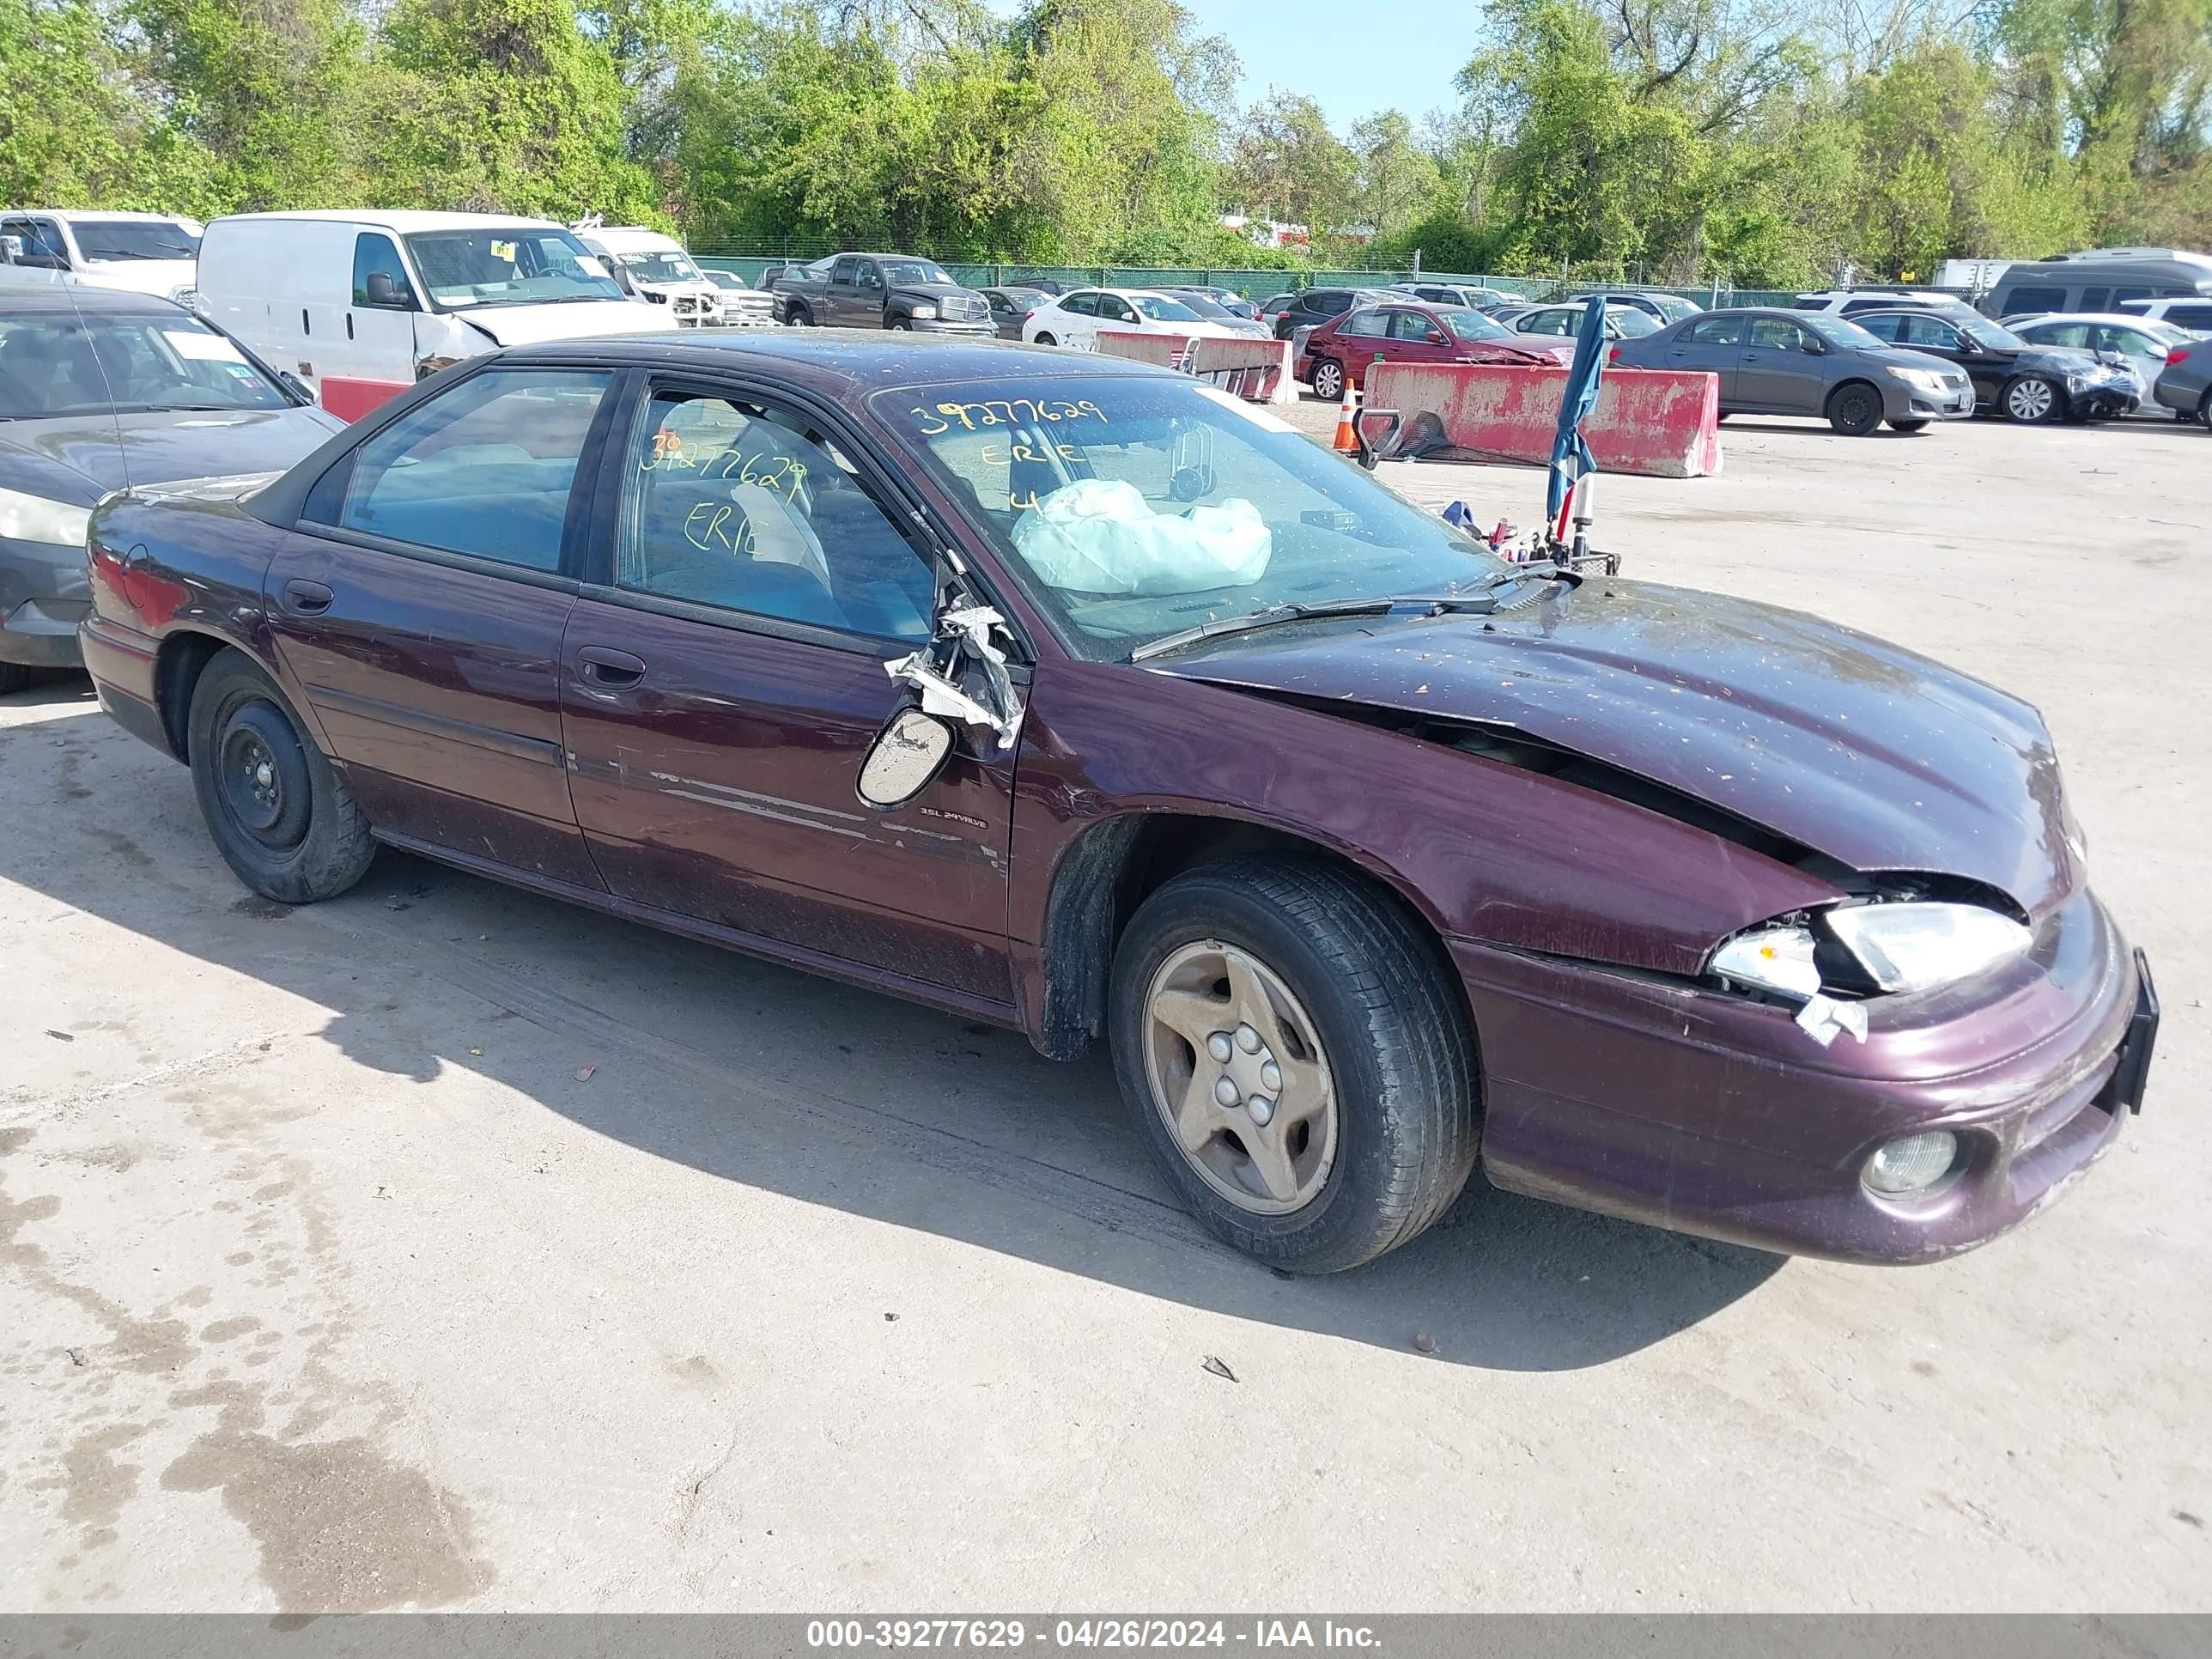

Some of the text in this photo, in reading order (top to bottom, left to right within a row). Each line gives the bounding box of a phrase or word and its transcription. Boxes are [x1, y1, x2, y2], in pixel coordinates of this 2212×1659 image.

[910, 399, 1109, 435] 39277629
[641, 434, 808, 508] 39277629
[981, 444, 1088, 465] ERIE
[684, 501, 769, 557] ERIE
